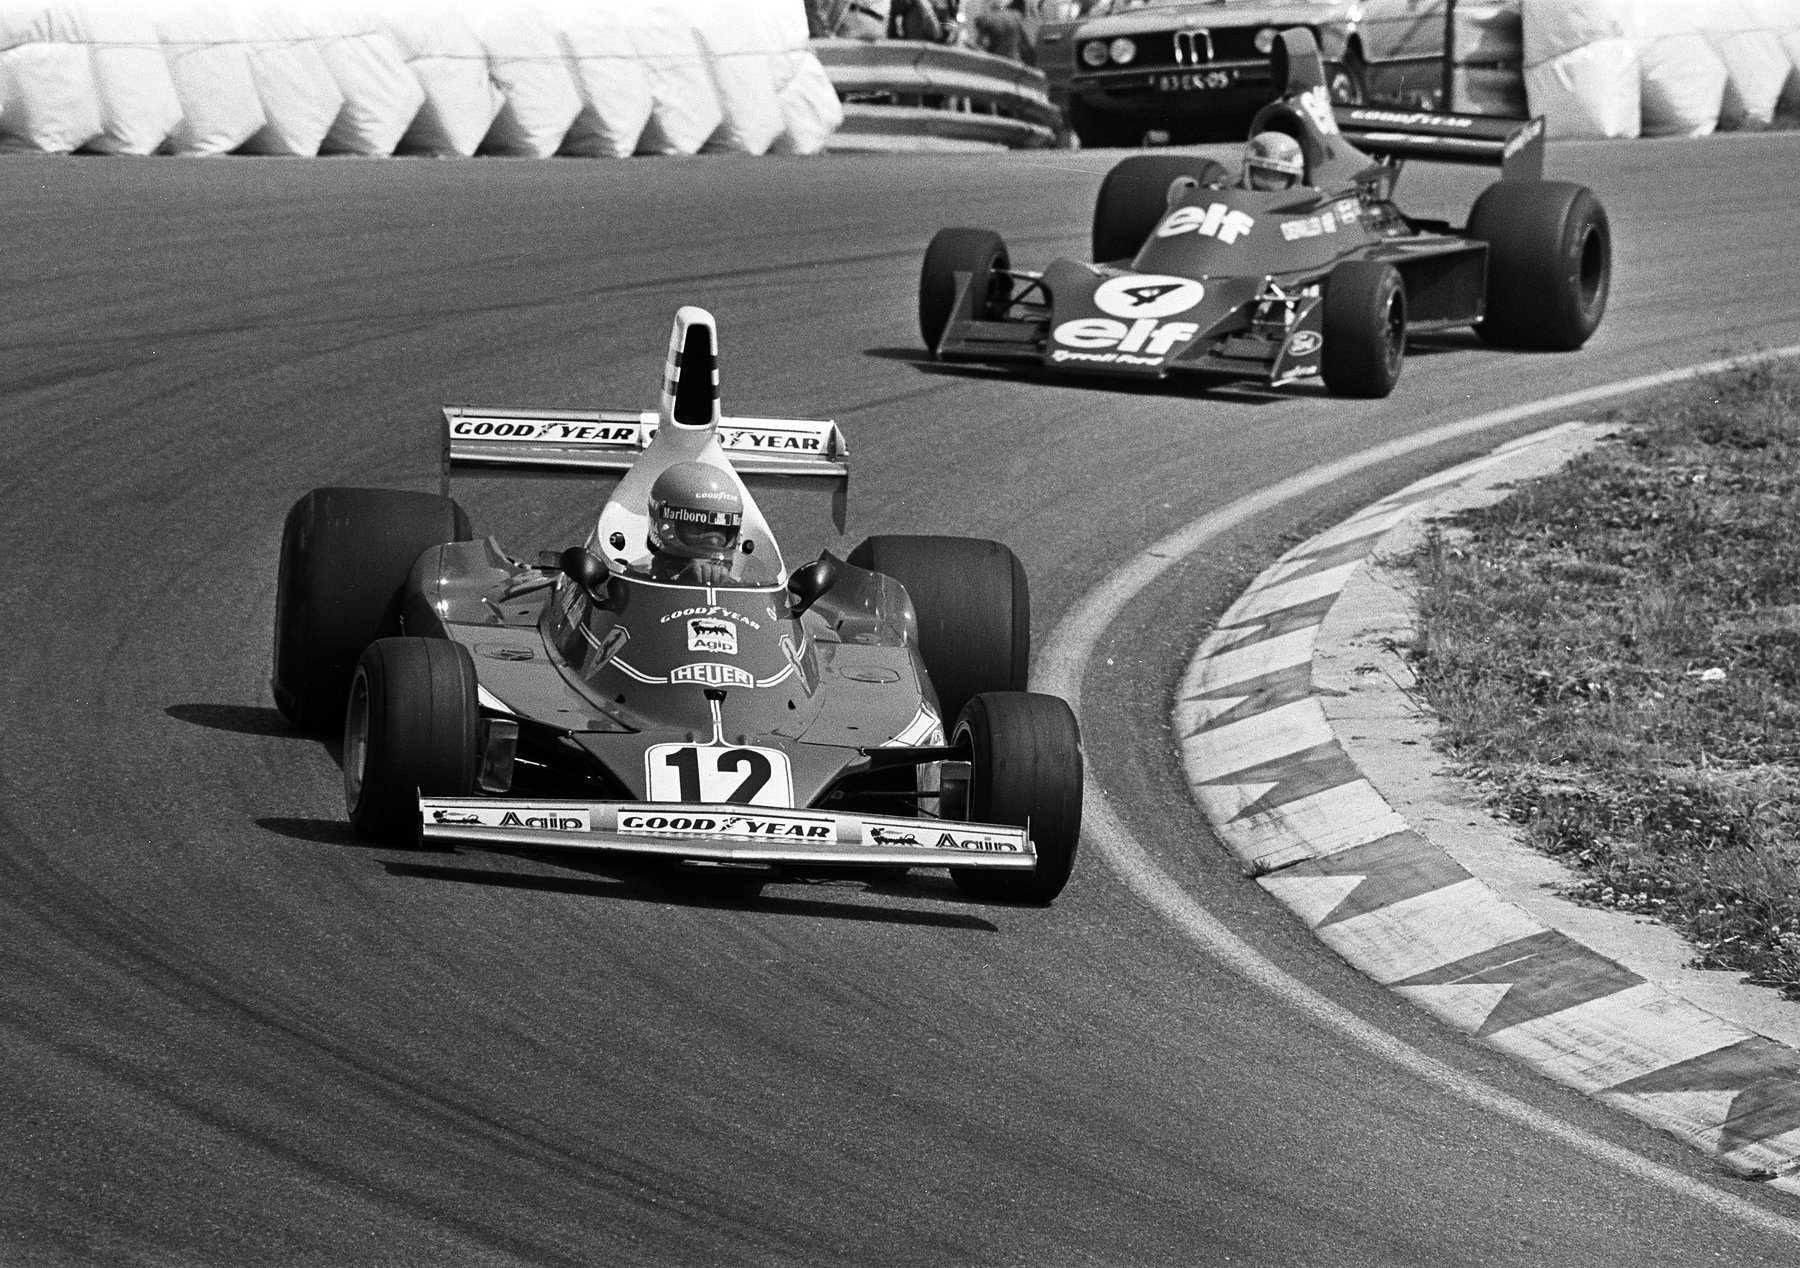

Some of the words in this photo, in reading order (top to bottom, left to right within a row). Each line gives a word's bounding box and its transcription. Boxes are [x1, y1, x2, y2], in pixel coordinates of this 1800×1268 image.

[1157, 203, 1254, 244] elf
[1122, 284, 1186, 307] 4
[1053, 318, 1199, 354] elf
[454, 420, 535, 437] GOOD
[560, 424, 635, 441] YEAR
[750, 434, 821, 450] YEAR
[663, 507, 707, 523] Marlboro
[694, 639, 733, 651] Agip
[677, 665, 749, 684] HEUER
[665, 747, 772, 805] 12
[499, 811, 583, 830] Agip
[622, 816, 716, 830] GOOD
[745, 821, 831, 838] YEAR
